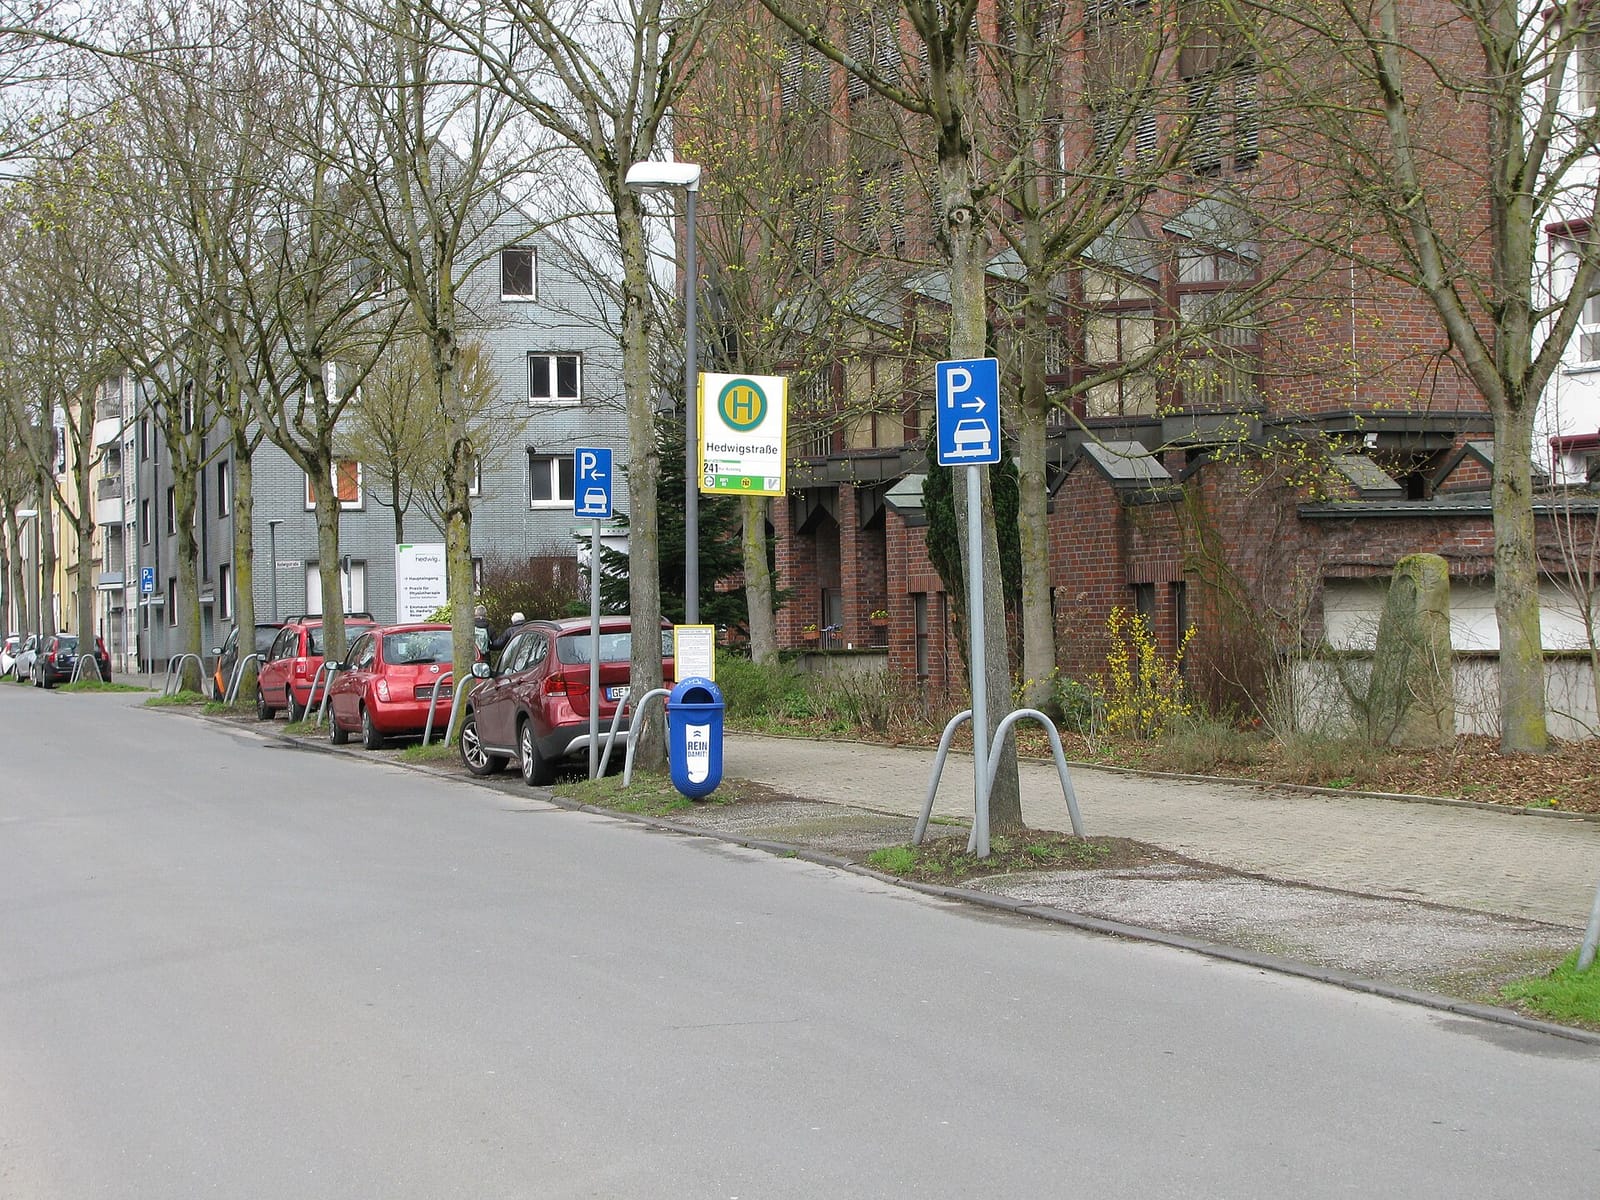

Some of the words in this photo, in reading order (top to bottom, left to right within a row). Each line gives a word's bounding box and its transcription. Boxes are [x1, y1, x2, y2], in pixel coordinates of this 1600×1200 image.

[946, 368, 973, 408] P
[732, 390, 753, 420] H
[706, 442, 778, 456] Hedwigstraße
[580, 452, 597, 480] P
[703, 462, 718, 473] 241
[143, 569, 149, 580] P
[687, 741, 708, 751] REIN
